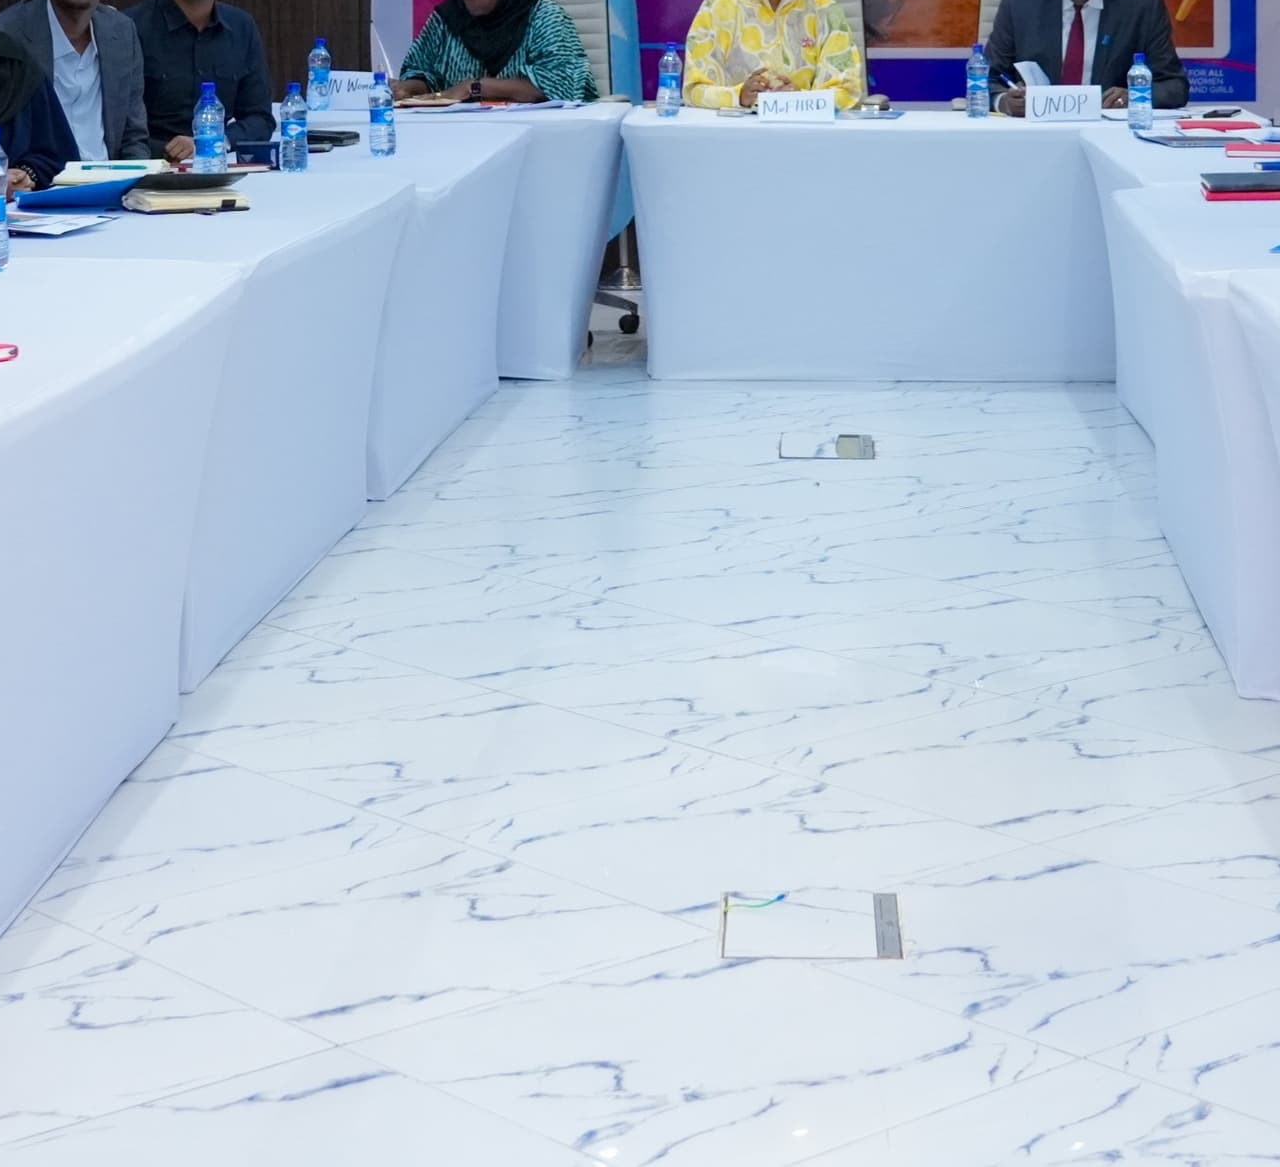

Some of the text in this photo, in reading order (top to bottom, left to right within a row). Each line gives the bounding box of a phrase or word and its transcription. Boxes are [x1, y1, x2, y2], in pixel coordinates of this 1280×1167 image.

[1188, 69, 1224, 77] FOR ALL
[1188, 78, 1224, 86] WOMEN
[1189, 86, 1234, 94] AND GIRLS
[1032, 95, 1088, 117] UNDP
